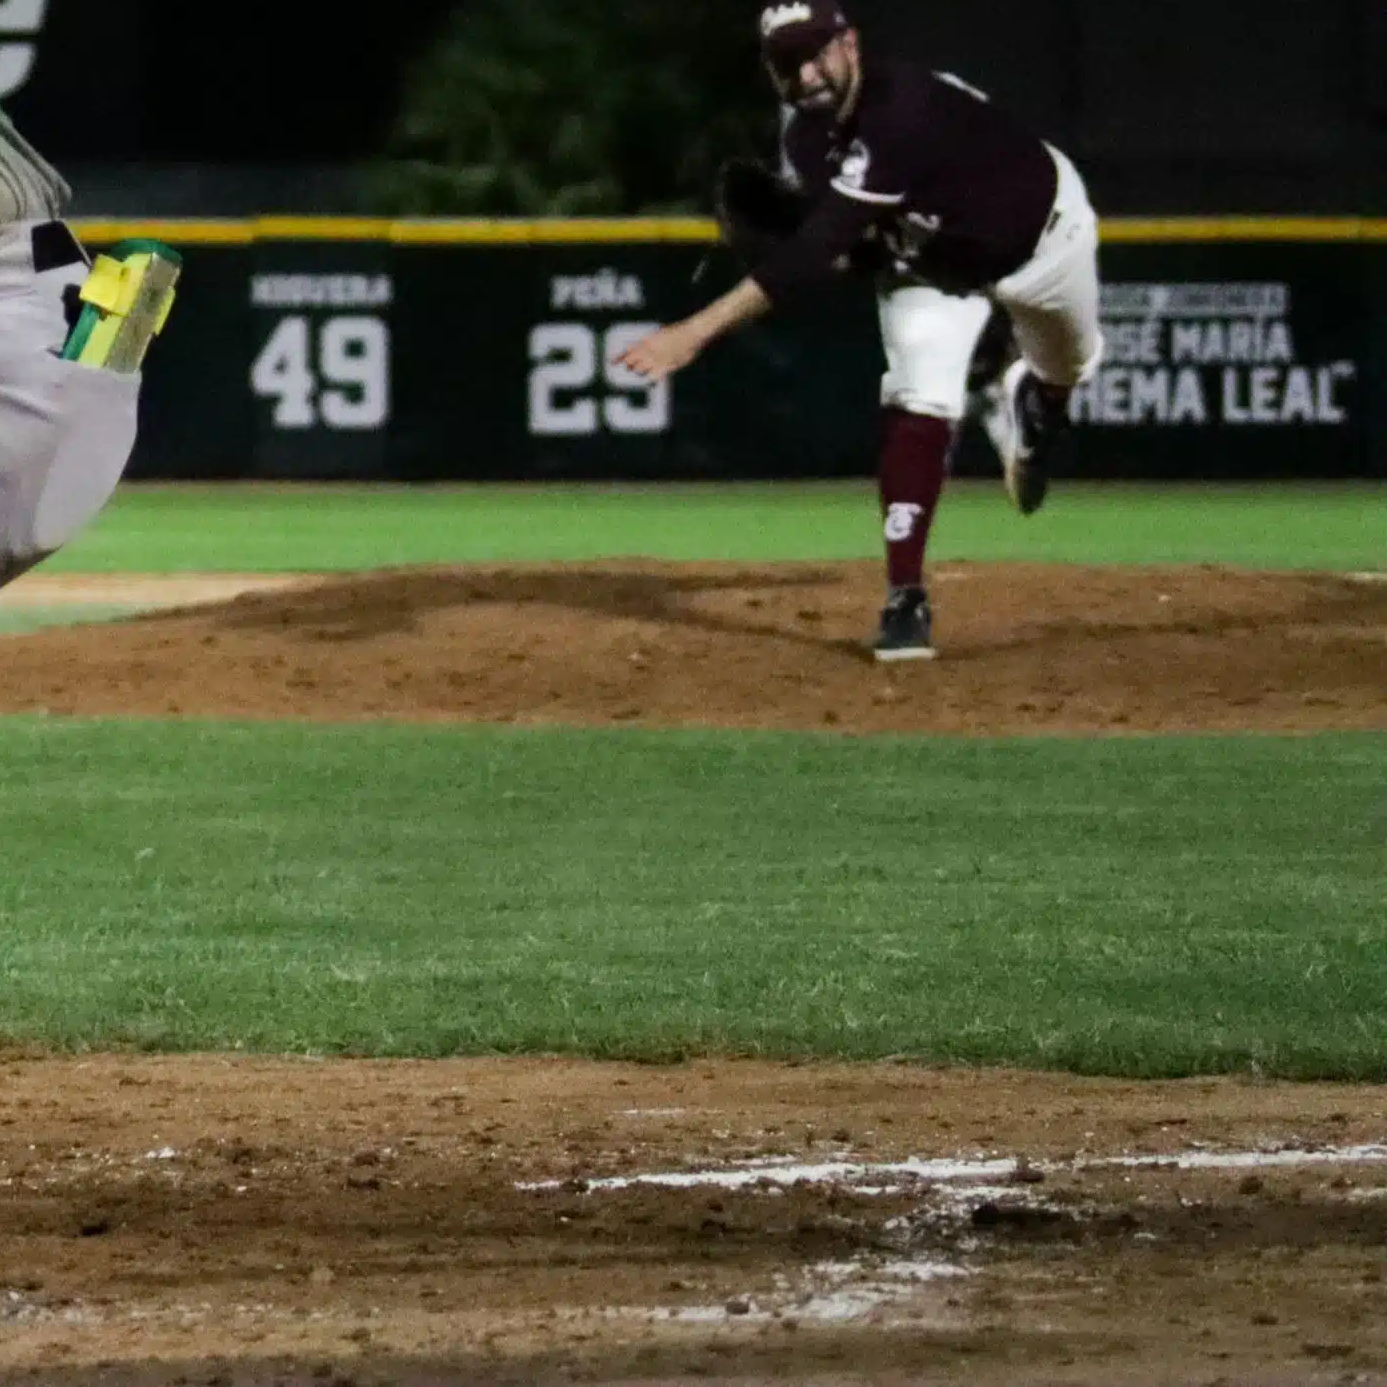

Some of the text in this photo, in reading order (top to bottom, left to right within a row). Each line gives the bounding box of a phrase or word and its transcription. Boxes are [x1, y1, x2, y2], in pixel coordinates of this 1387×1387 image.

[250, 315, 389, 429] 49
[529, 322, 670, 434] 29
[1171, 312, 1293, 362] MARÍA
